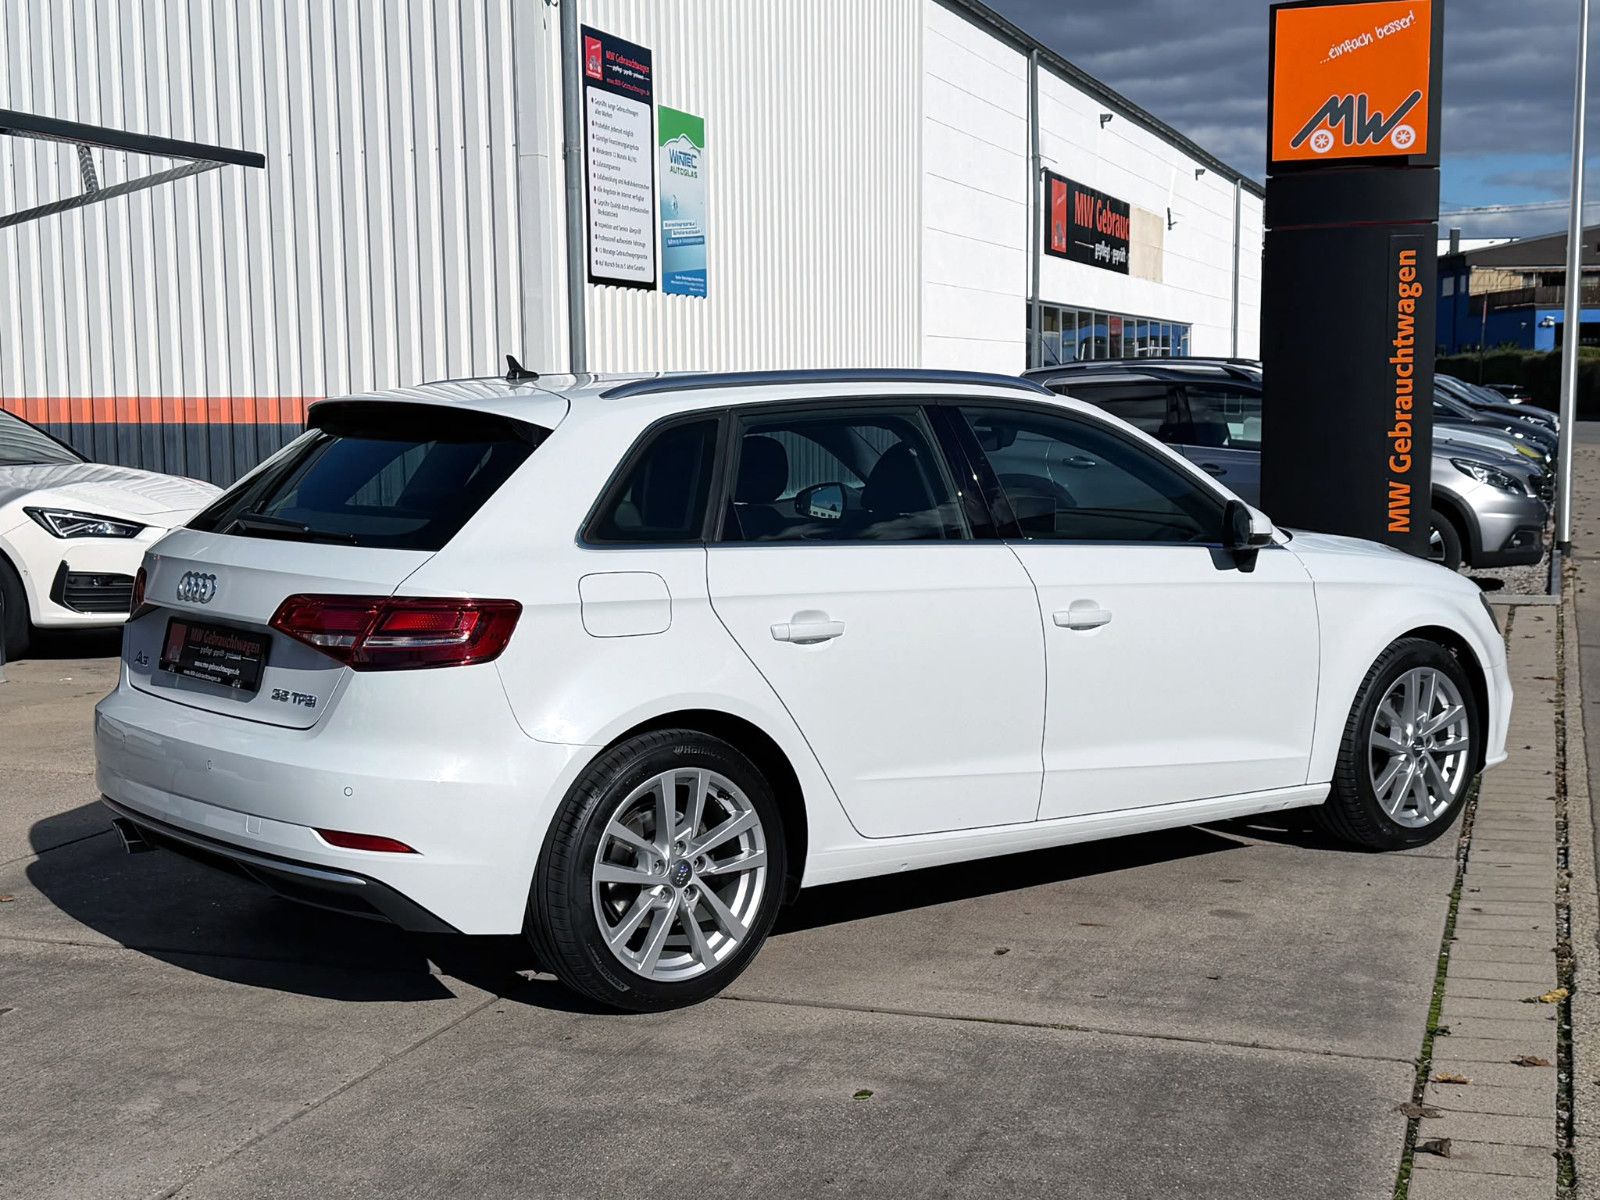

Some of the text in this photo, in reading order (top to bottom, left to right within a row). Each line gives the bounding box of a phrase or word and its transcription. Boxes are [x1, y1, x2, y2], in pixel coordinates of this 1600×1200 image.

[1375, 10, 1416, 39] besser!
[1290, 89, 1422, 148] MW
[669, 148, 697, 169] WINTEC
[669, 165, 698, 179] AUTOGLAS
[1074, 190, 1094, 229] MW
[1388, 249, 1423, 533] MW Gebrauchtwagen
[134, 649, 149, 666] A3
